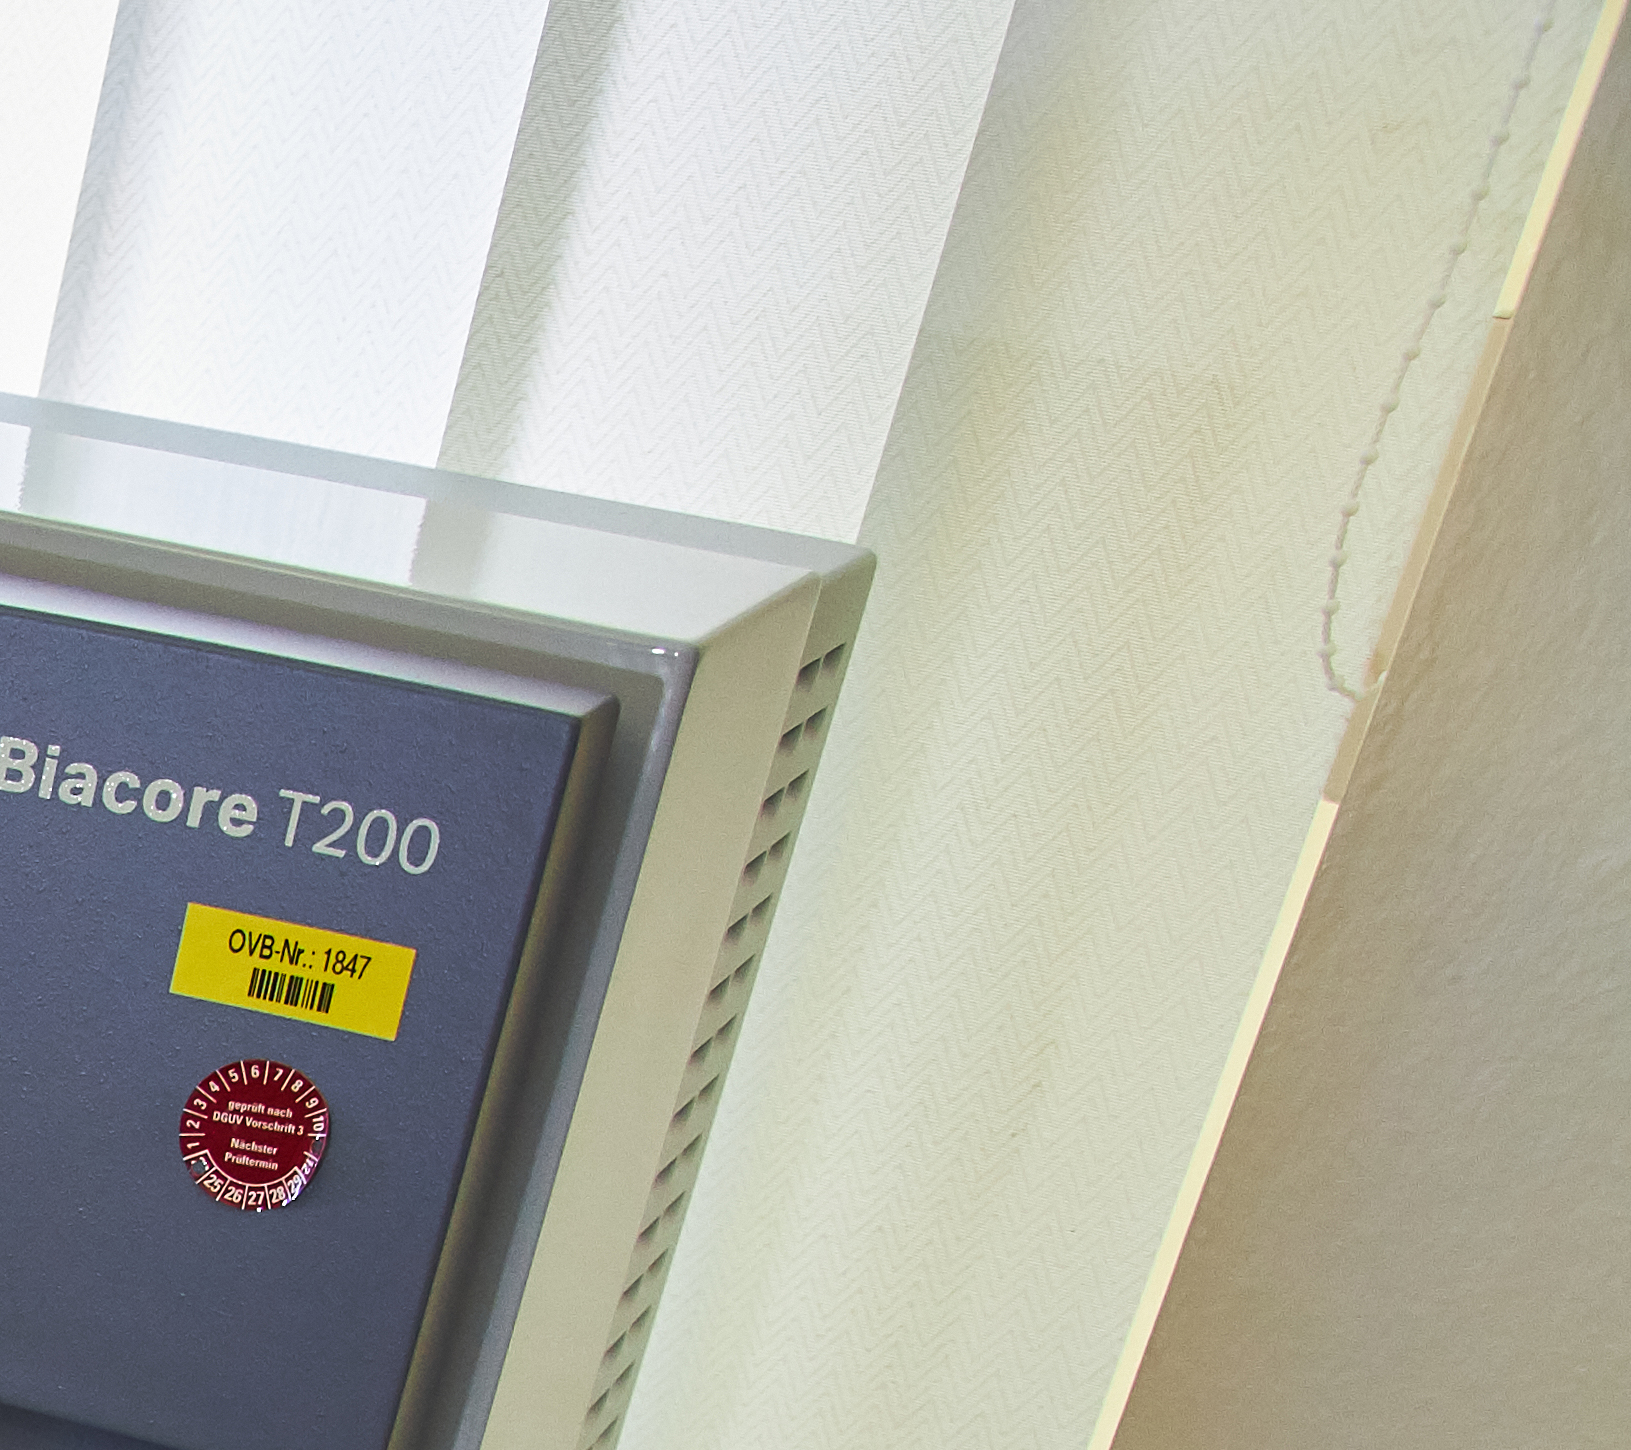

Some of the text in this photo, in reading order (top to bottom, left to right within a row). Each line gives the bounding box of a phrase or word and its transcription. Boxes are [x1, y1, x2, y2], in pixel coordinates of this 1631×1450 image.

[278, 788, 440, 875] T200
[228, 929, 372, 980] OVB-Nr.: 1847
[227, 1068, 239, 1082] 5
[250, 1064, 260, 1078] 6
[273, 1068, 283, 1081] 7
[208, 1081, 220, 1093] 4
[290, 1079, 304, 1093] 8
[193, 1098, 207, 1110] 3
[228, 1100, 293, 1119] geprüft nach
[305, 1097, 319, 1109] 9
[186, 1119, 200, 1129] 2
[212, 1110, 305, 1136] DGUV Vorschrift 3
[230, 1137, 278, 1155] Nächster
[224, 1152, 279, 1171] Prüftermin
[203, 1174, 224, 1193] 25
[224, 1186, 244, 1203] 26
[248, 1190, 265, 1206] 27
[269, 1186, 286, 1203] 28
